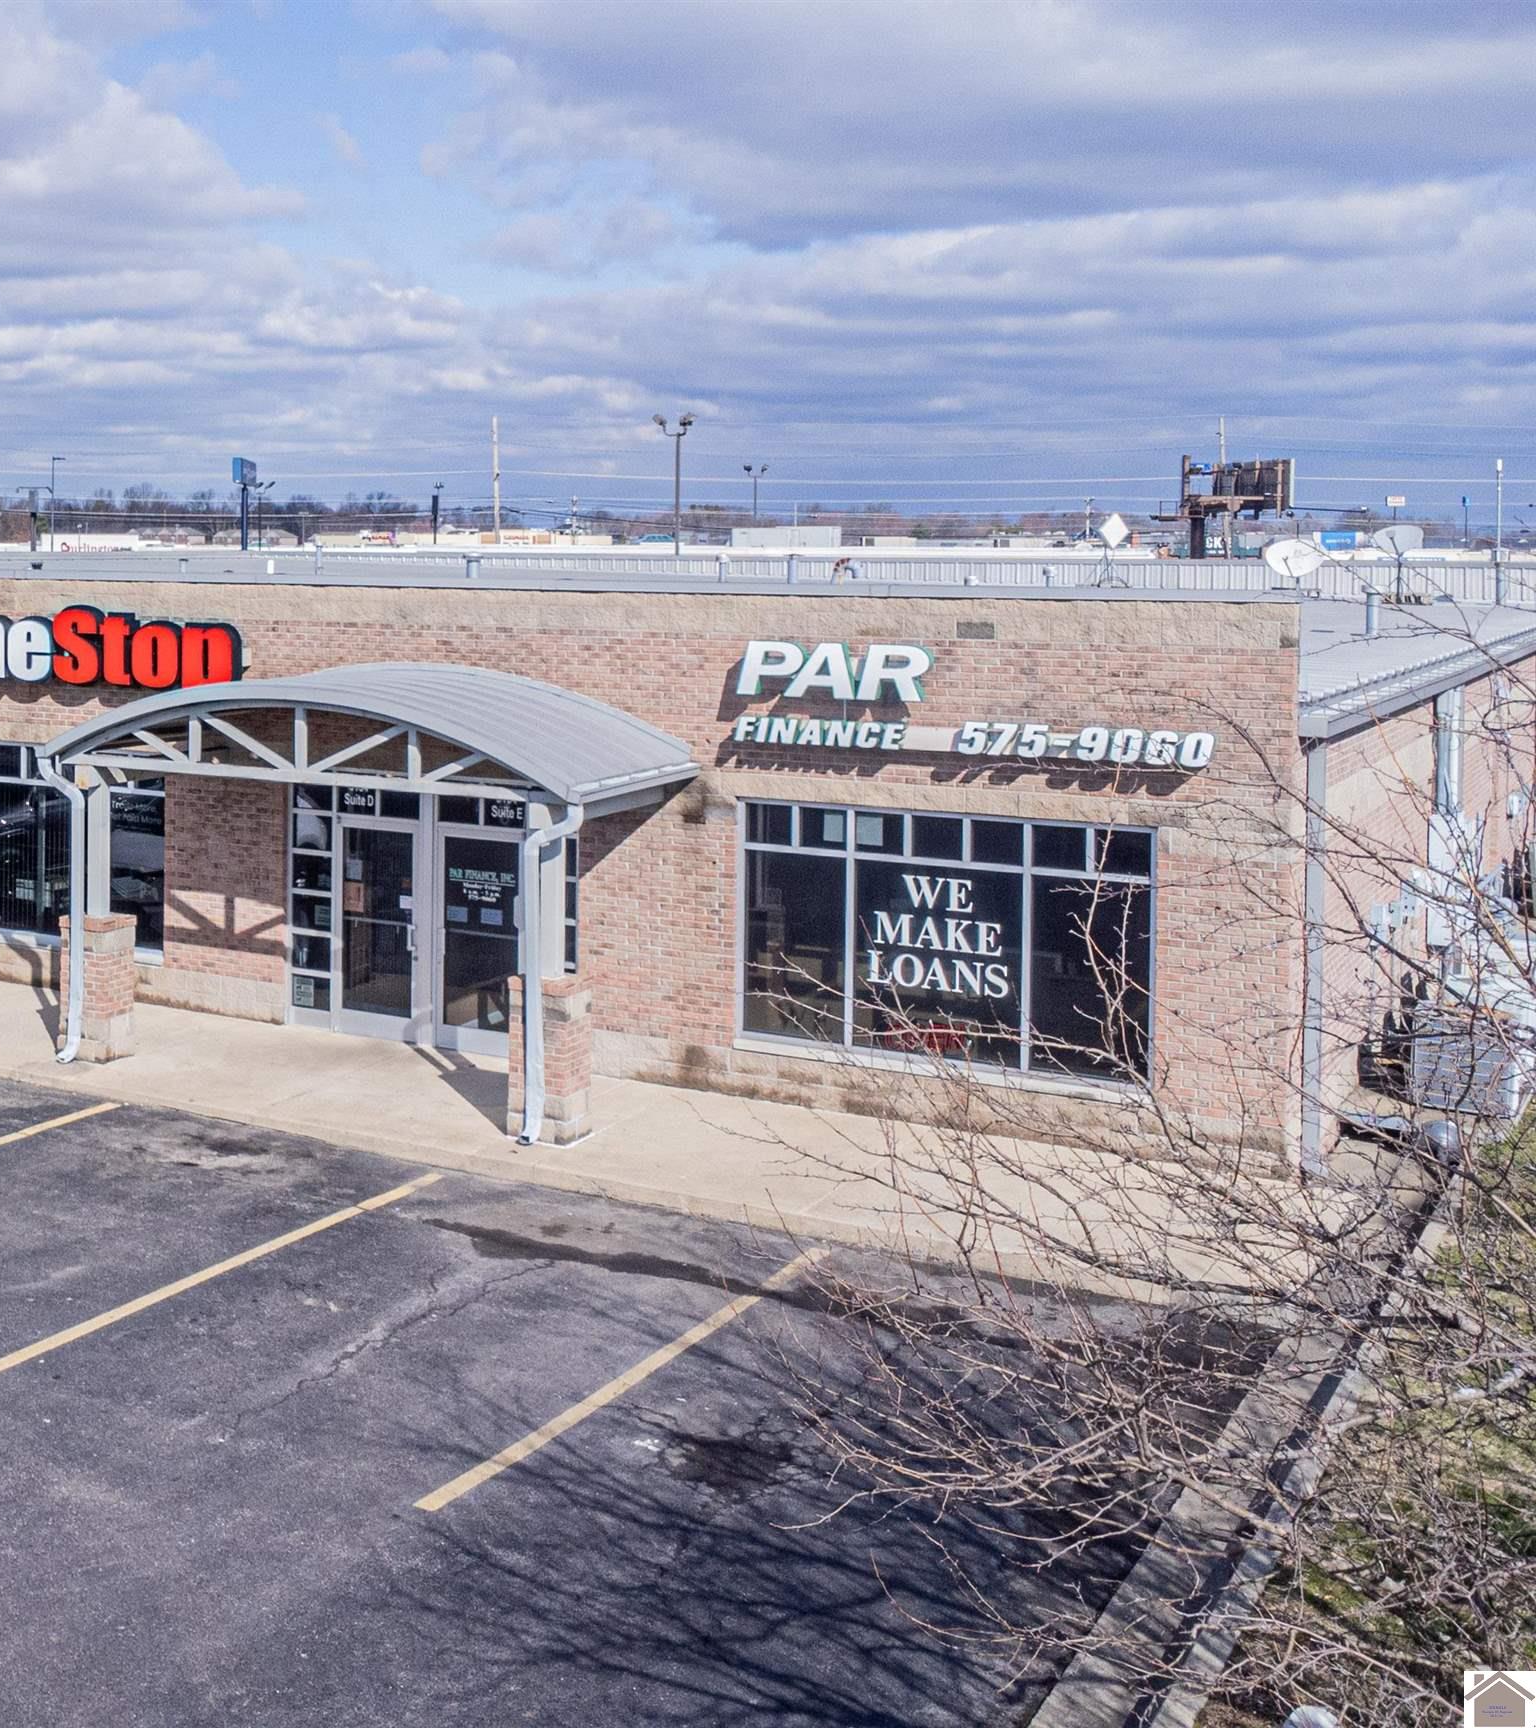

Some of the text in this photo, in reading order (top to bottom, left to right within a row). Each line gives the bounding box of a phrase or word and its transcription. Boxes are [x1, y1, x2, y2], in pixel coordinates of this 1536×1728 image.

[735, 639, 934, 702] PAR
[733, 716, 1215, 768] FINANCE 575-9060
[344, 792, 374, 807] Suite D
[490, 804, 523, 820] Suite E
[449, 867, 463, 878] PAR
[500, 872, 516, 884] INC.
[901, 874, 973, 913] WE
[873, 911, 1002, 957] MAKE
[867, 949, 1009, 999] LOANS
